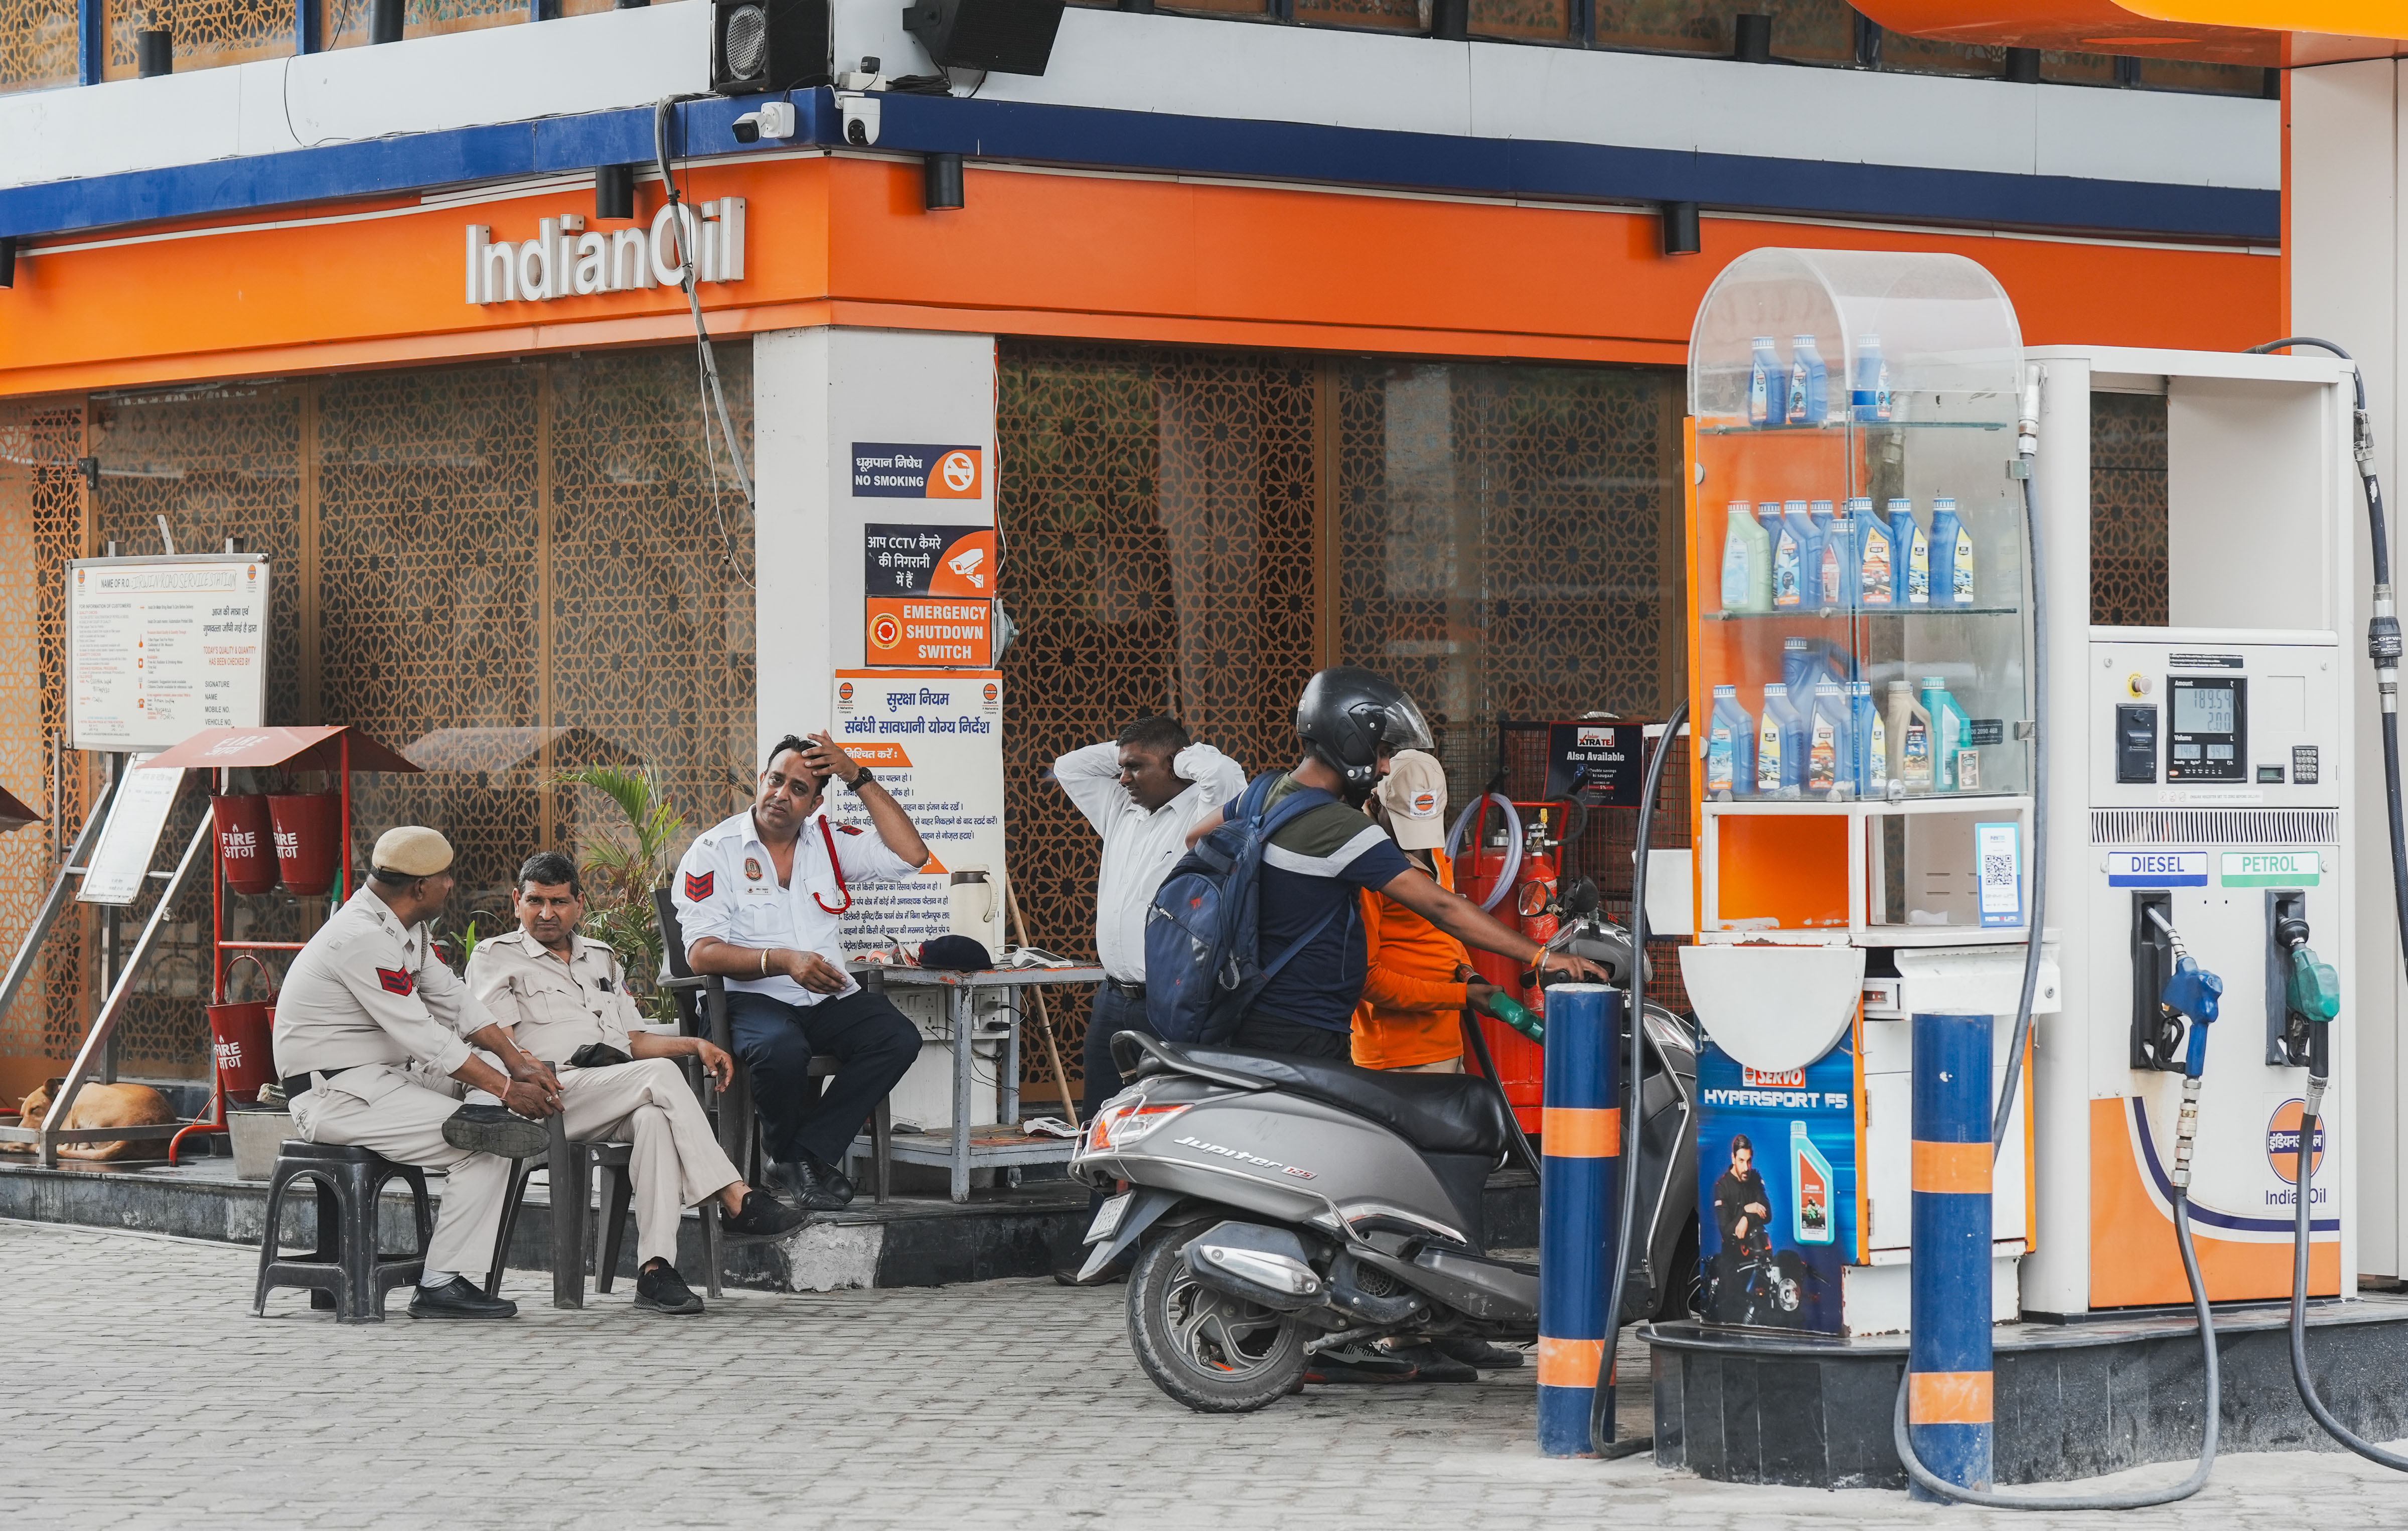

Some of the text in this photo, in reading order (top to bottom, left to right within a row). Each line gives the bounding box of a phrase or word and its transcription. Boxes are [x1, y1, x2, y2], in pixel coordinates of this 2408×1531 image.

[466, 197, 745, 305] IndianOil
[856, 455, 923, 472] धूम्रपान निषेध
[855, 475, 924, 487] NO SMOKING
[868, 533, 942, 549] आप CCTV कैमरे
[878, 552, 930, 568] की निगरानी
[101, 580, 113, 588] NAME
[114, 579, 120, 588] OF
[896, 572, 904, 586] में
[223, 606, 229, 615] की
[904, 605, 987, 620] EMERGENCY
[234, 622, 242, 633] गई
[243, 622, 247, 632] है
[906, 625, 983, 639] SHUTDOWN
[919, 645, 971, 658] SWITCH
[887, 688, 949, 712] सुरक्षा नियम
[2195, 690, 2230, 709] 189.54
[845, 716, 990, 733] संबंधी सावधानी योग्य निर्देश
[1567, 751, 1624, 761] Also Available
[901, 773, 907, 782] हो
[891, 788, 902, 796] ऑफ
[904, 788, 910, 796] हो
[927, 802, 940, 811] इंजन
[951, 801, 960, 810] रखें
[844, 816, 861, 825] दो/तीन
[915, 816, 920, 825] से
[935, 815, 955, 825] निकलने
[956, 816, 962, 825] के
[974, 815, 985, 825] स्टार्ट
[222, 831, 256, 846] FIRE
[936, 830, 941, 839] से
[224, 845, 256, 859] आग
[2132, 856, 2298, 872] DIESEL PETROL
[857, 882, 861, 891] से
[862, 882, 874, 891] किसी
[933, 881, 938, 891] हो
[879, 896, 889, 906] कोई
[890, 896, 895, 905] भी
[923, 896, 936, 904] फैलाव
[943, 896, 948, 904] हो
[844, 911, 860, 920] डिलेवरी
[861, 910, 882, 923] यूनिट/टैंक
[884, 910, 894, 919] फार्म
[910, 910, 920, 919] बिना
[922, 910, 941, 922] फ्लैमप्रूफ
[859, 925, 865, 934] की
[866, 925, 878, 934] किसी
[880, 925, 885, 934] भी
[900, 924, 906, 933] की
[925, 925, 938, 935] पेट्रोल
[844, 940, 871, 951] पेट्रोल/डीजल
[873, 940, 883, 949] भरते
[213, 1042, 241, 1056] FIRE
[1757, 1070, 1803, 1085] SERVO
[1704, 1089, 1848, 1109] HYPERSPORT F5
[2269, 1133, 2322, 1152] इंडियनल
[1174, 1136, 1314, 1179] Jupiter 125
[2266, 1188, 2326, 1205] IndiaOil
